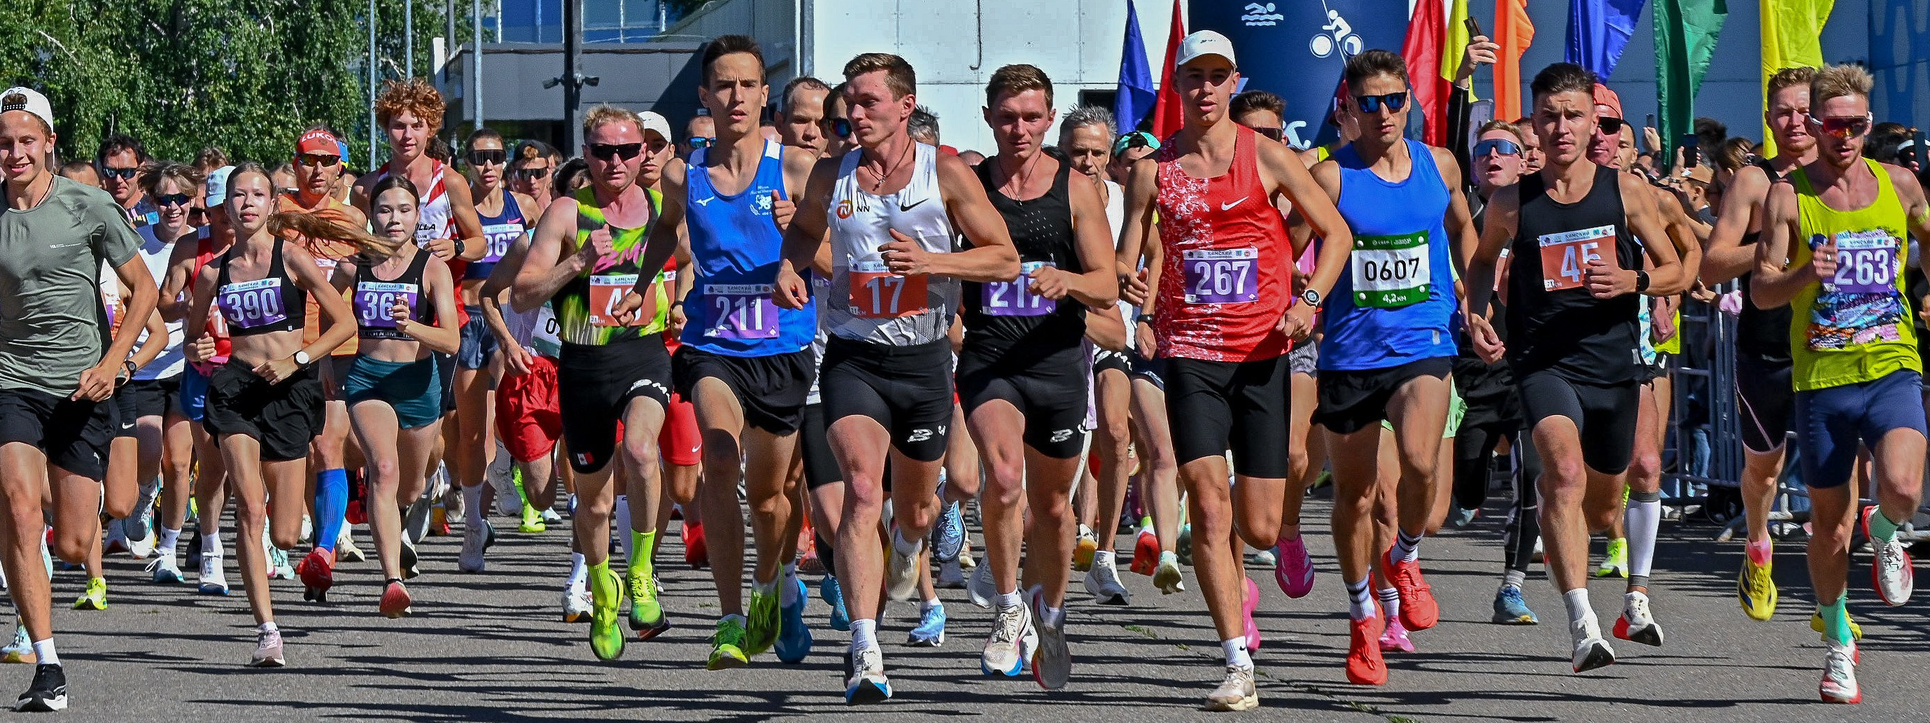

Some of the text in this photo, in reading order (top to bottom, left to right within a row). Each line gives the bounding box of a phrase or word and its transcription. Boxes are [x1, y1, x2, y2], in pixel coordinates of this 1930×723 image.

[1194, 261, 1251, 295] 267
[1364, 257, 1420, 281] 0607
[1834, 249, 1890, 285] 263
[227, 289, 279, 322] 390
[605, 287, 642, 321] 4
[867, 275, 905, 314] 17
[716, 296, 763, 331] 211
